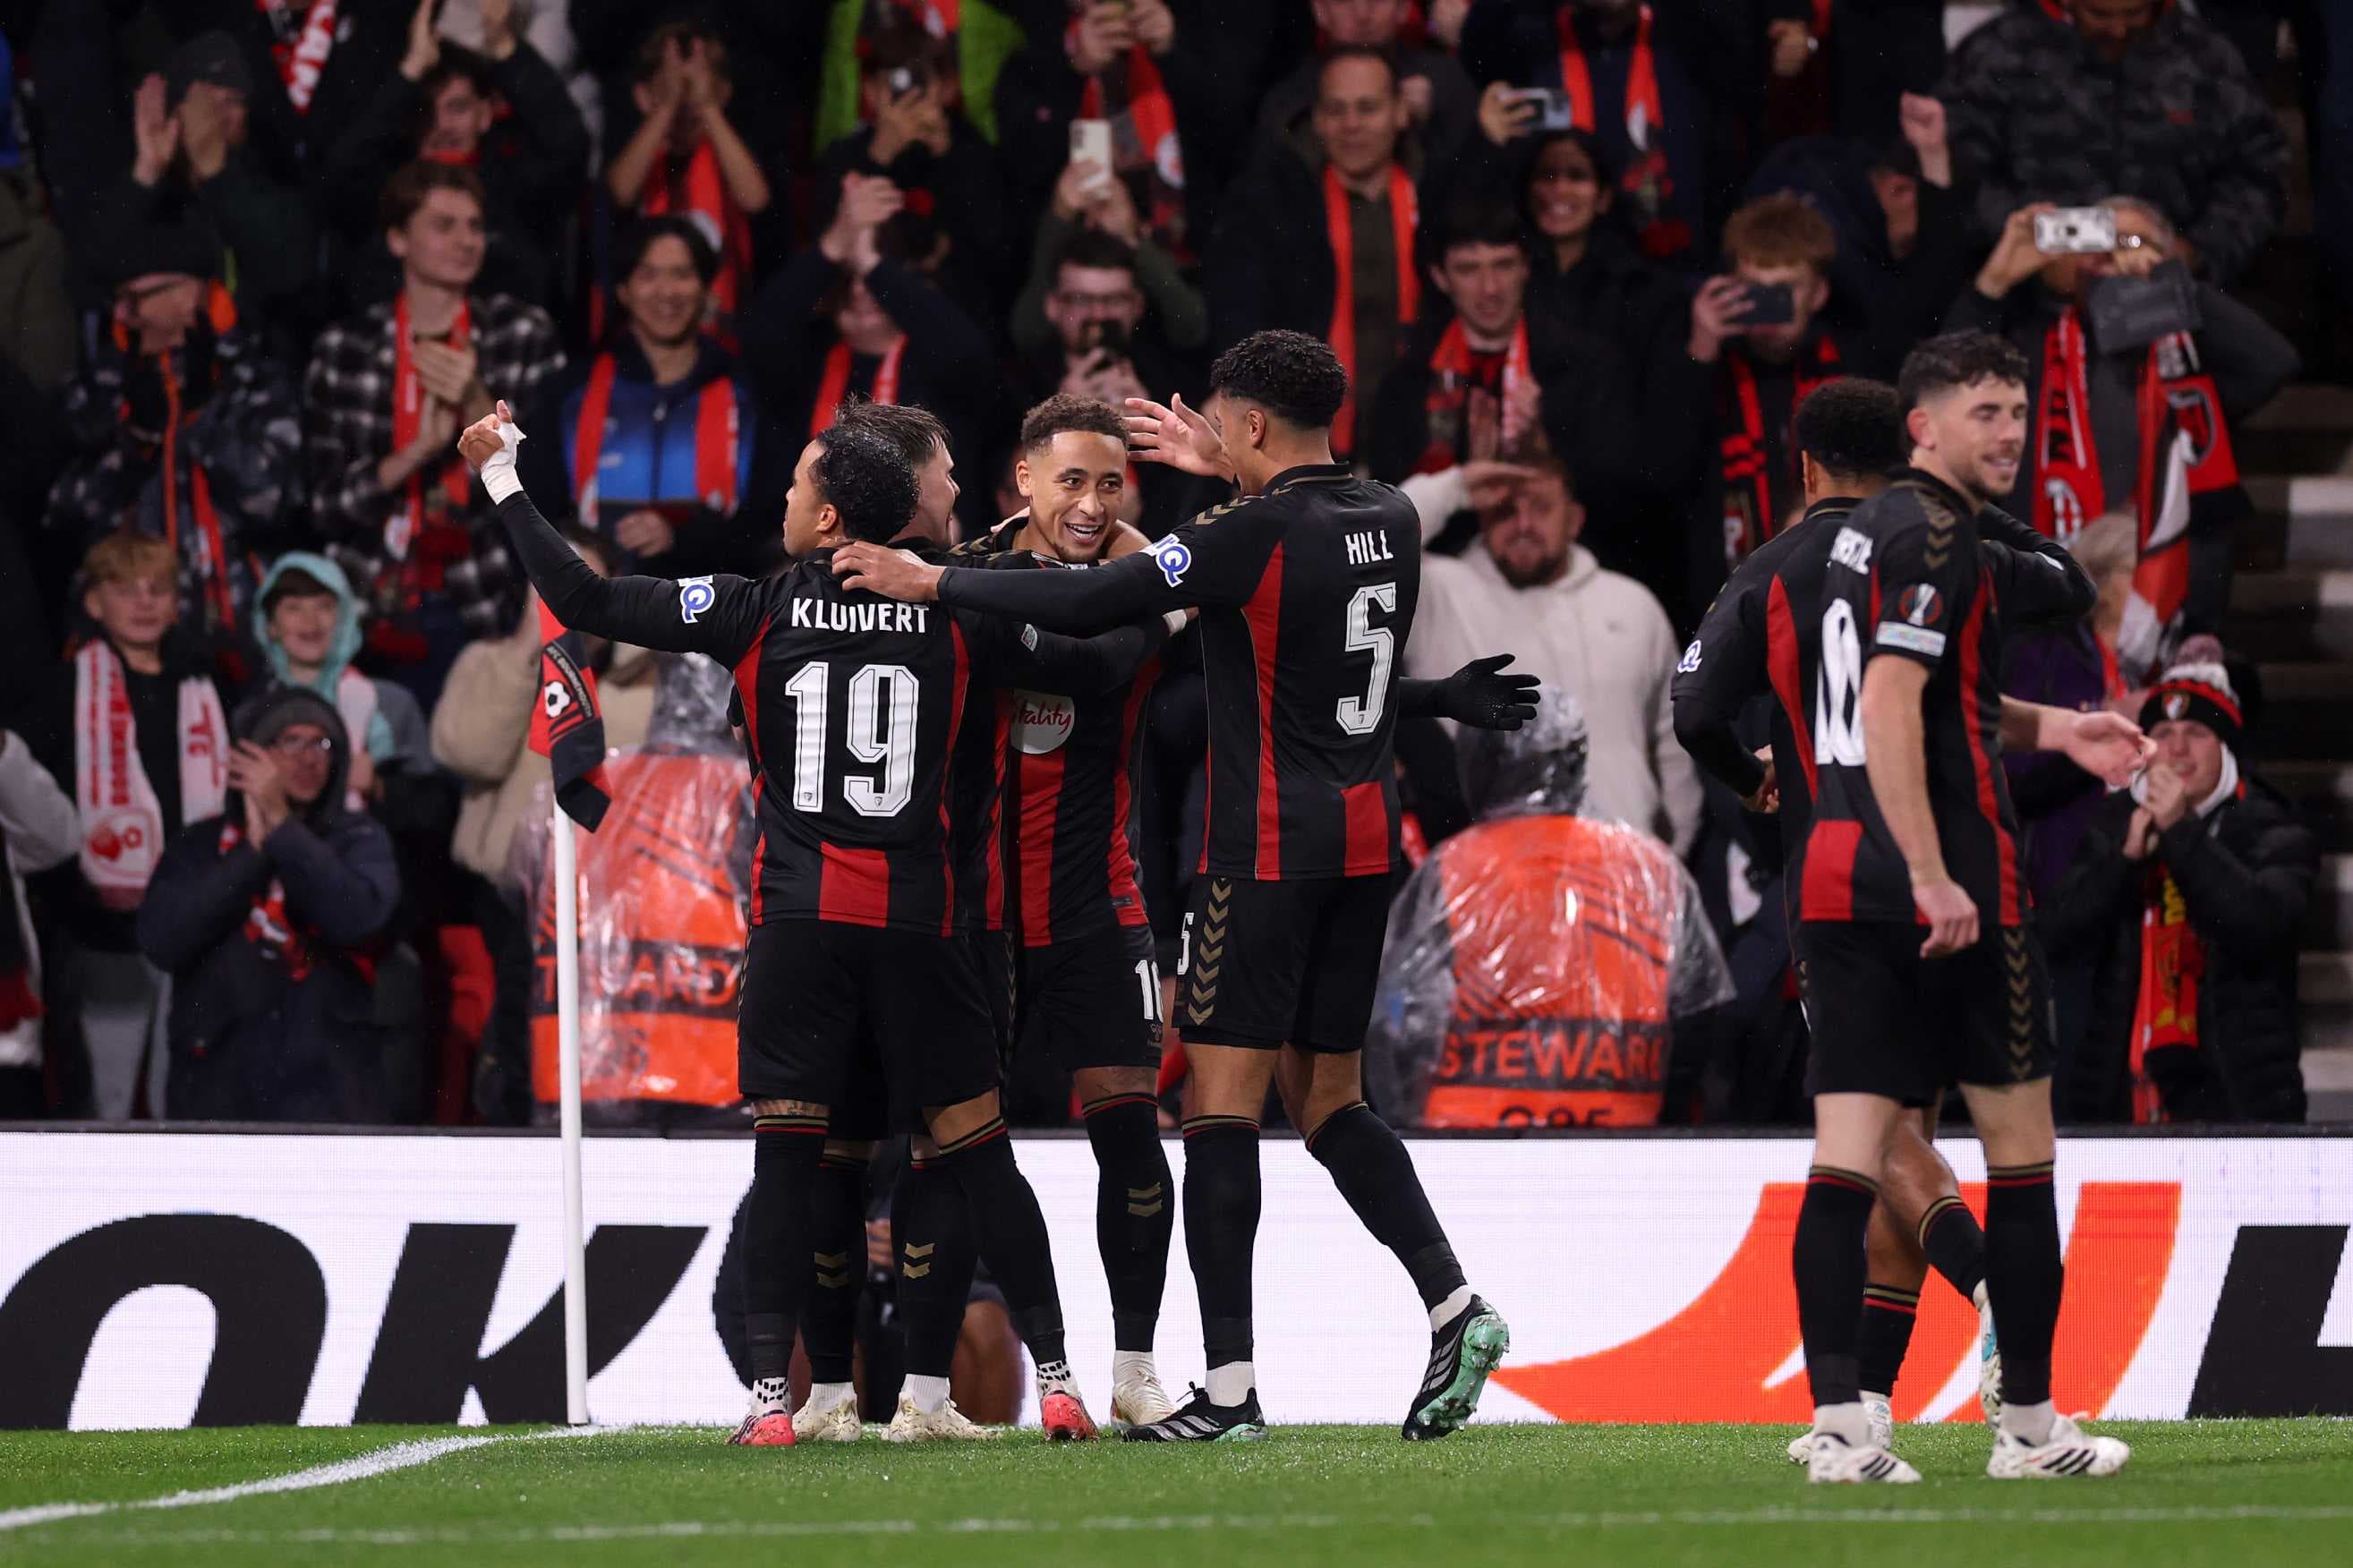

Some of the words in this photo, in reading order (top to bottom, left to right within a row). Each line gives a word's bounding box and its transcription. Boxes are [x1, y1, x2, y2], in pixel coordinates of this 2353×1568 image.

[1344, 530, 1394, 565] HILL
[791, 597, 930, 634] KLUIVERT
[1336, 582, 1396, 735] 5
[785, 660, 920, 817] 19
[1177, 912, 1195, 976] 5
